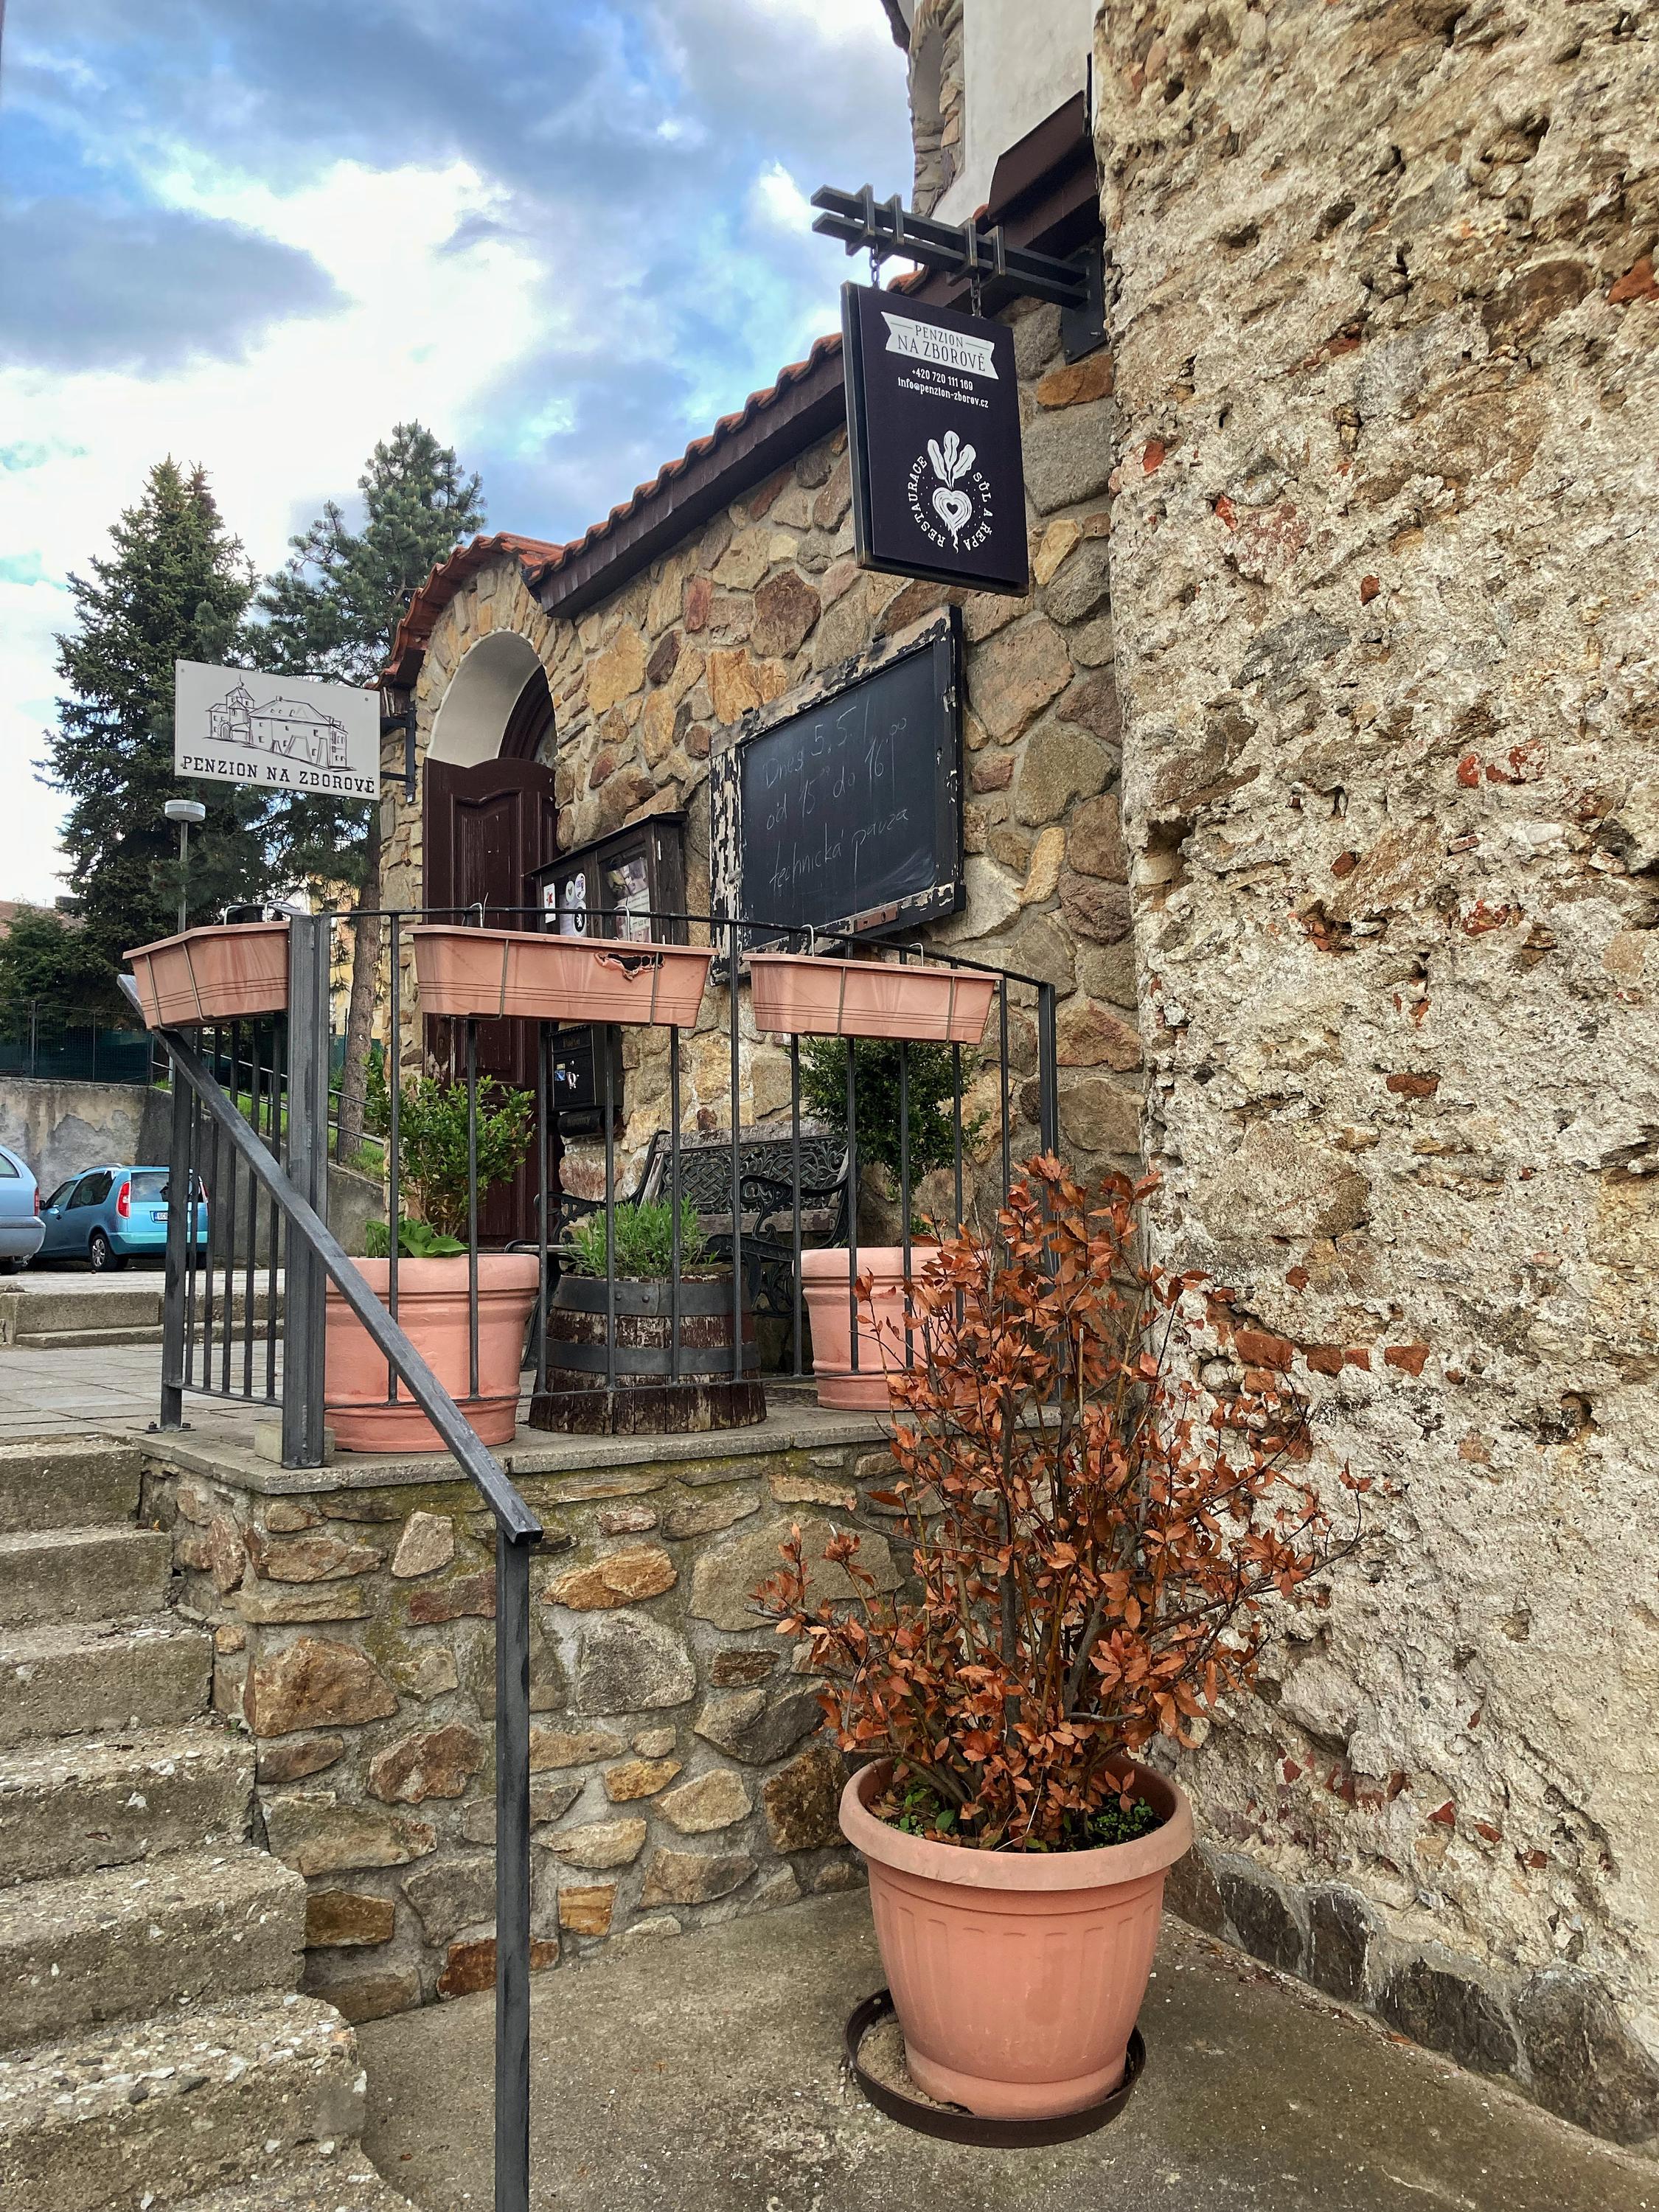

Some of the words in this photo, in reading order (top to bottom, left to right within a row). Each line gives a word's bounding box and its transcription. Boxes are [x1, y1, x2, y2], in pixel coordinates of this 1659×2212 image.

[915, 325, 963, 348] PENZION
[898, 335, 919, 354] NA
[922, 341, 985, 372] ZBOROVĚ
[912, 368, 931, 380] +420
[932, 371, 946, 384] 720
[947, 376, 959, 388] 111
[908, 456, 946, 547] RESTAURACE
[973, 472, 991, 502] SŮL
[983, 507, 993, 517] A
[963, 521, 992, 551] ŘEPA
[182, 755, 258, 779] PENZION
[266, 767, 291, 782] NA
[299, 771, 375, 794] ZBOROVĚ
[767, 793, 787, 830] od
[832, 765, 855, 798] do
[852, 808, 909, 887] pauza
